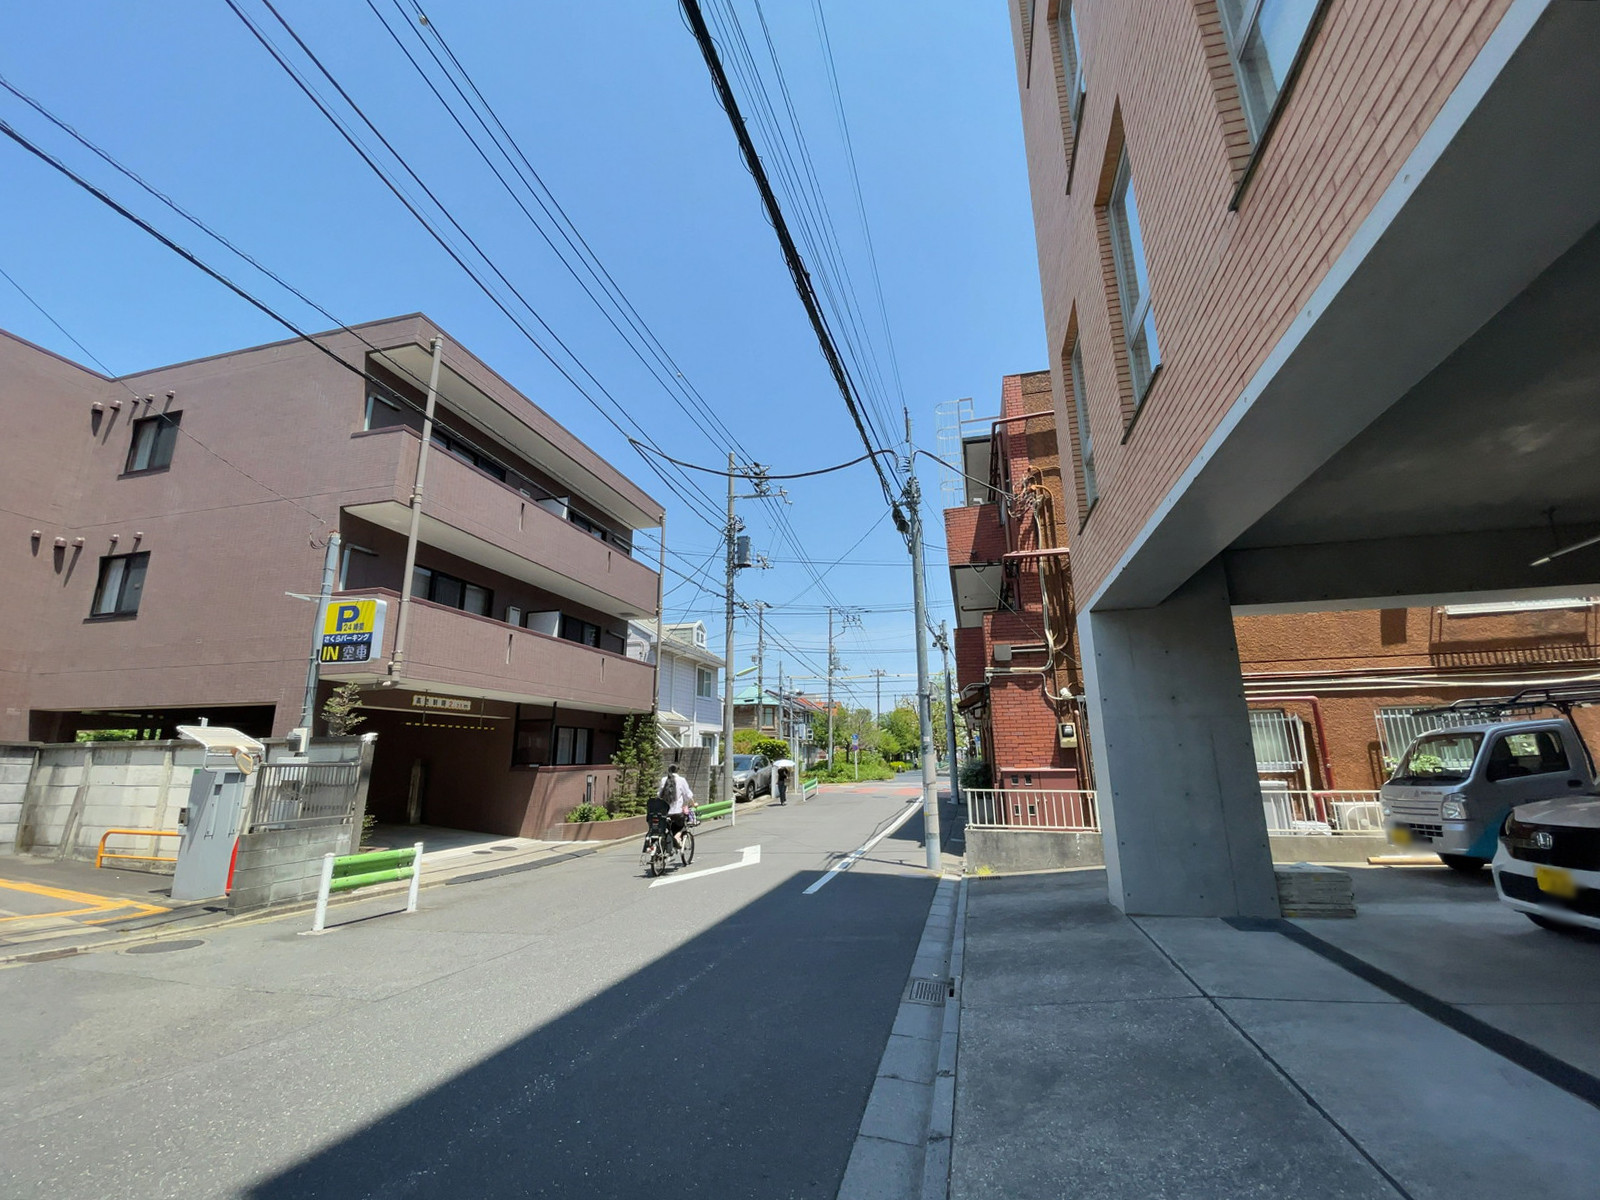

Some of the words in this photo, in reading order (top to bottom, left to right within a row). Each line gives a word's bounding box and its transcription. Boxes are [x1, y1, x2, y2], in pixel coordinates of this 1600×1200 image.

[336, 605, 360, 631] P
[324, 634, 369, 643] さくらパーキング
[322, 646, 339, 660] IN
[342, 645, 366, 660] 空車
